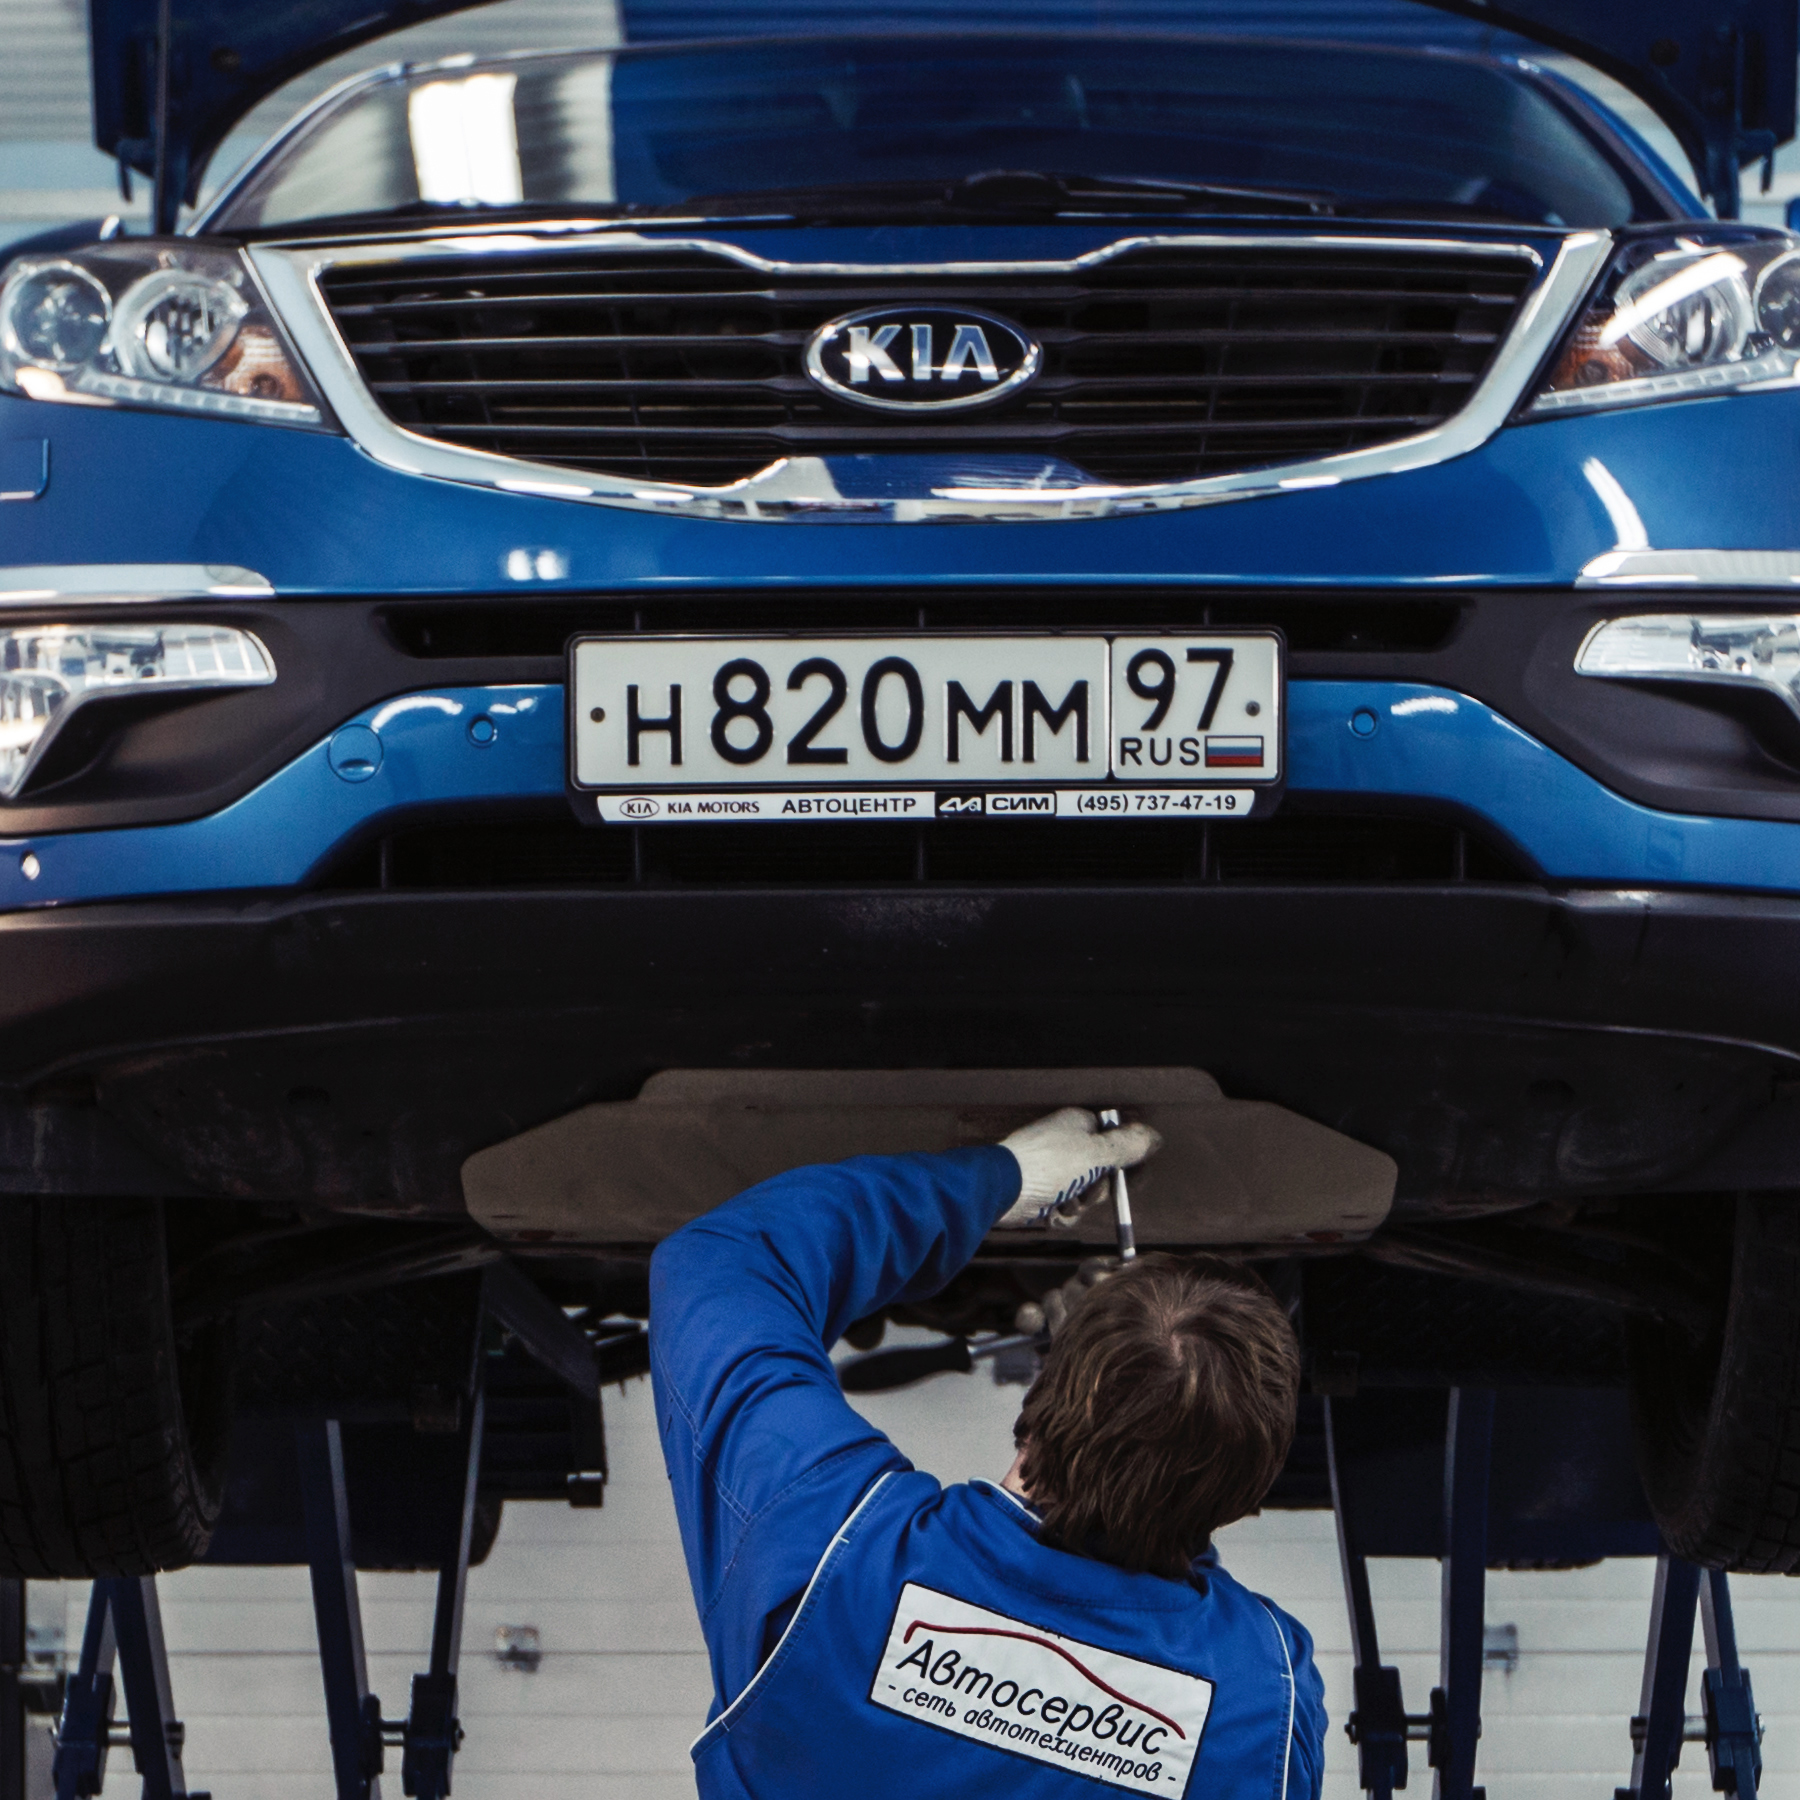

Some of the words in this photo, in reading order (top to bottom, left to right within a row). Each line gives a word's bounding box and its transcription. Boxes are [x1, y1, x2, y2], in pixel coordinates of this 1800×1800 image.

[846, 323, 1001, 383] KIA
[1126, 647, 1234, 731] 97
[1120, 737, 1200, 766] RUS
[667, 802, 693, 814] KIA
[697, 801, 760, 814] MOTORS
[781, 798, 917, 816] АВТОЦЕНТР
[991, 797, 1050, 811] СИМ
[1076, 793, 1130, 814] (495)
[1135, 794, 1237, 811] 737-47-19
[895, 1639, 1169, 1756] Автосервис
[902, 1686, 957, 1718] сеть
[963, 1708, 1163, 1783] автотехцентров
